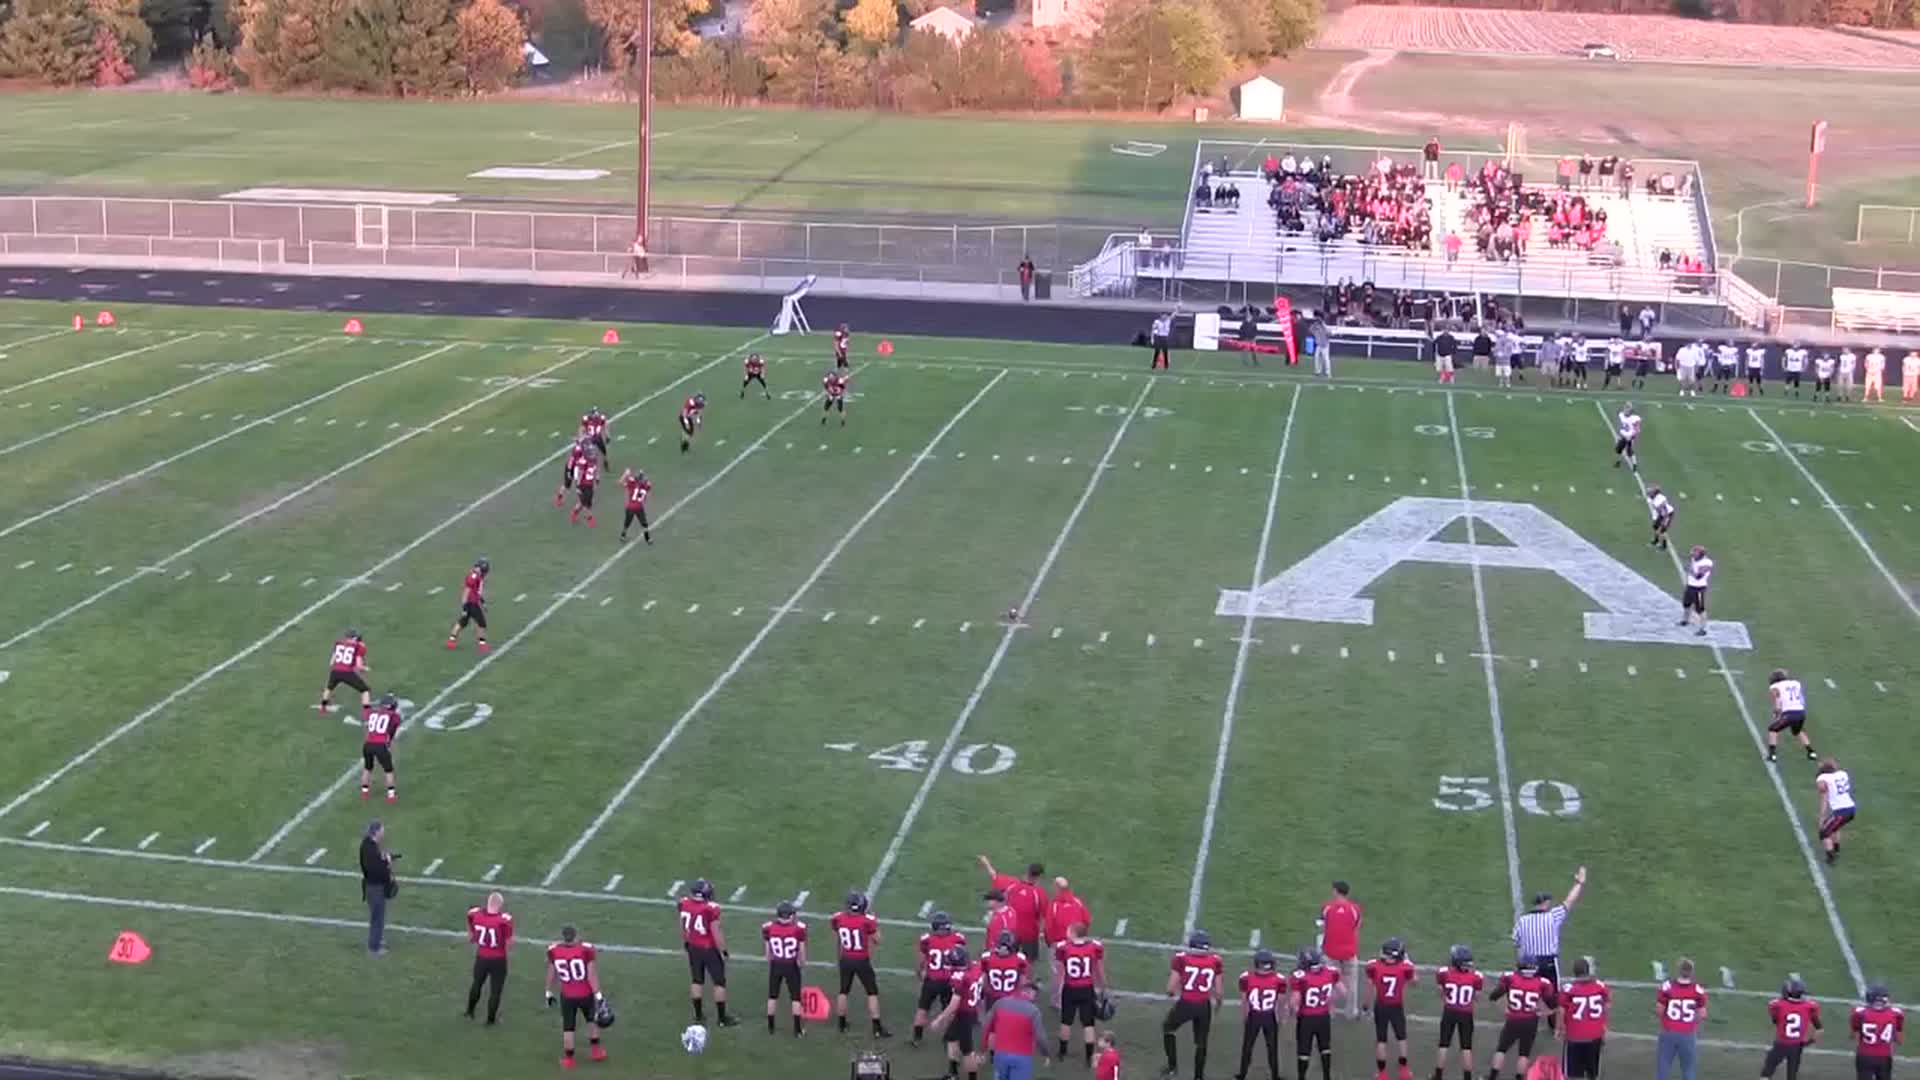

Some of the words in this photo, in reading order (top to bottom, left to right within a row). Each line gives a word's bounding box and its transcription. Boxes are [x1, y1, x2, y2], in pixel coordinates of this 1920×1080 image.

[867, 740, 1016, 775] 40
[1432, 775, 1581, 816] 50
[680, 910, 707, 936] 74
[474, 924, 498, 948] 71
[769, 936, 798, 959] 82
[838, 926, 863, 951] 81
[554, 958, 586, 982] 50
[1066, 956, 1092, 979] 61
[1184, 966, 1216, 993] 73
[988, 968, 1018, 993] 62
[1382, 976, 1398, 998] 7
[1248, 988, 1277, 1012] 42
[1444, 983, 1474, 1007] 30
[1508, 988, 1539, 1012] 55
[1571, 994, 1603, 1020] 75
[1666, 998, 1696, 1023] 65
[1785, 1013, 1801, 1039] 2
[1861, 1023, 1893, 1046] 54
